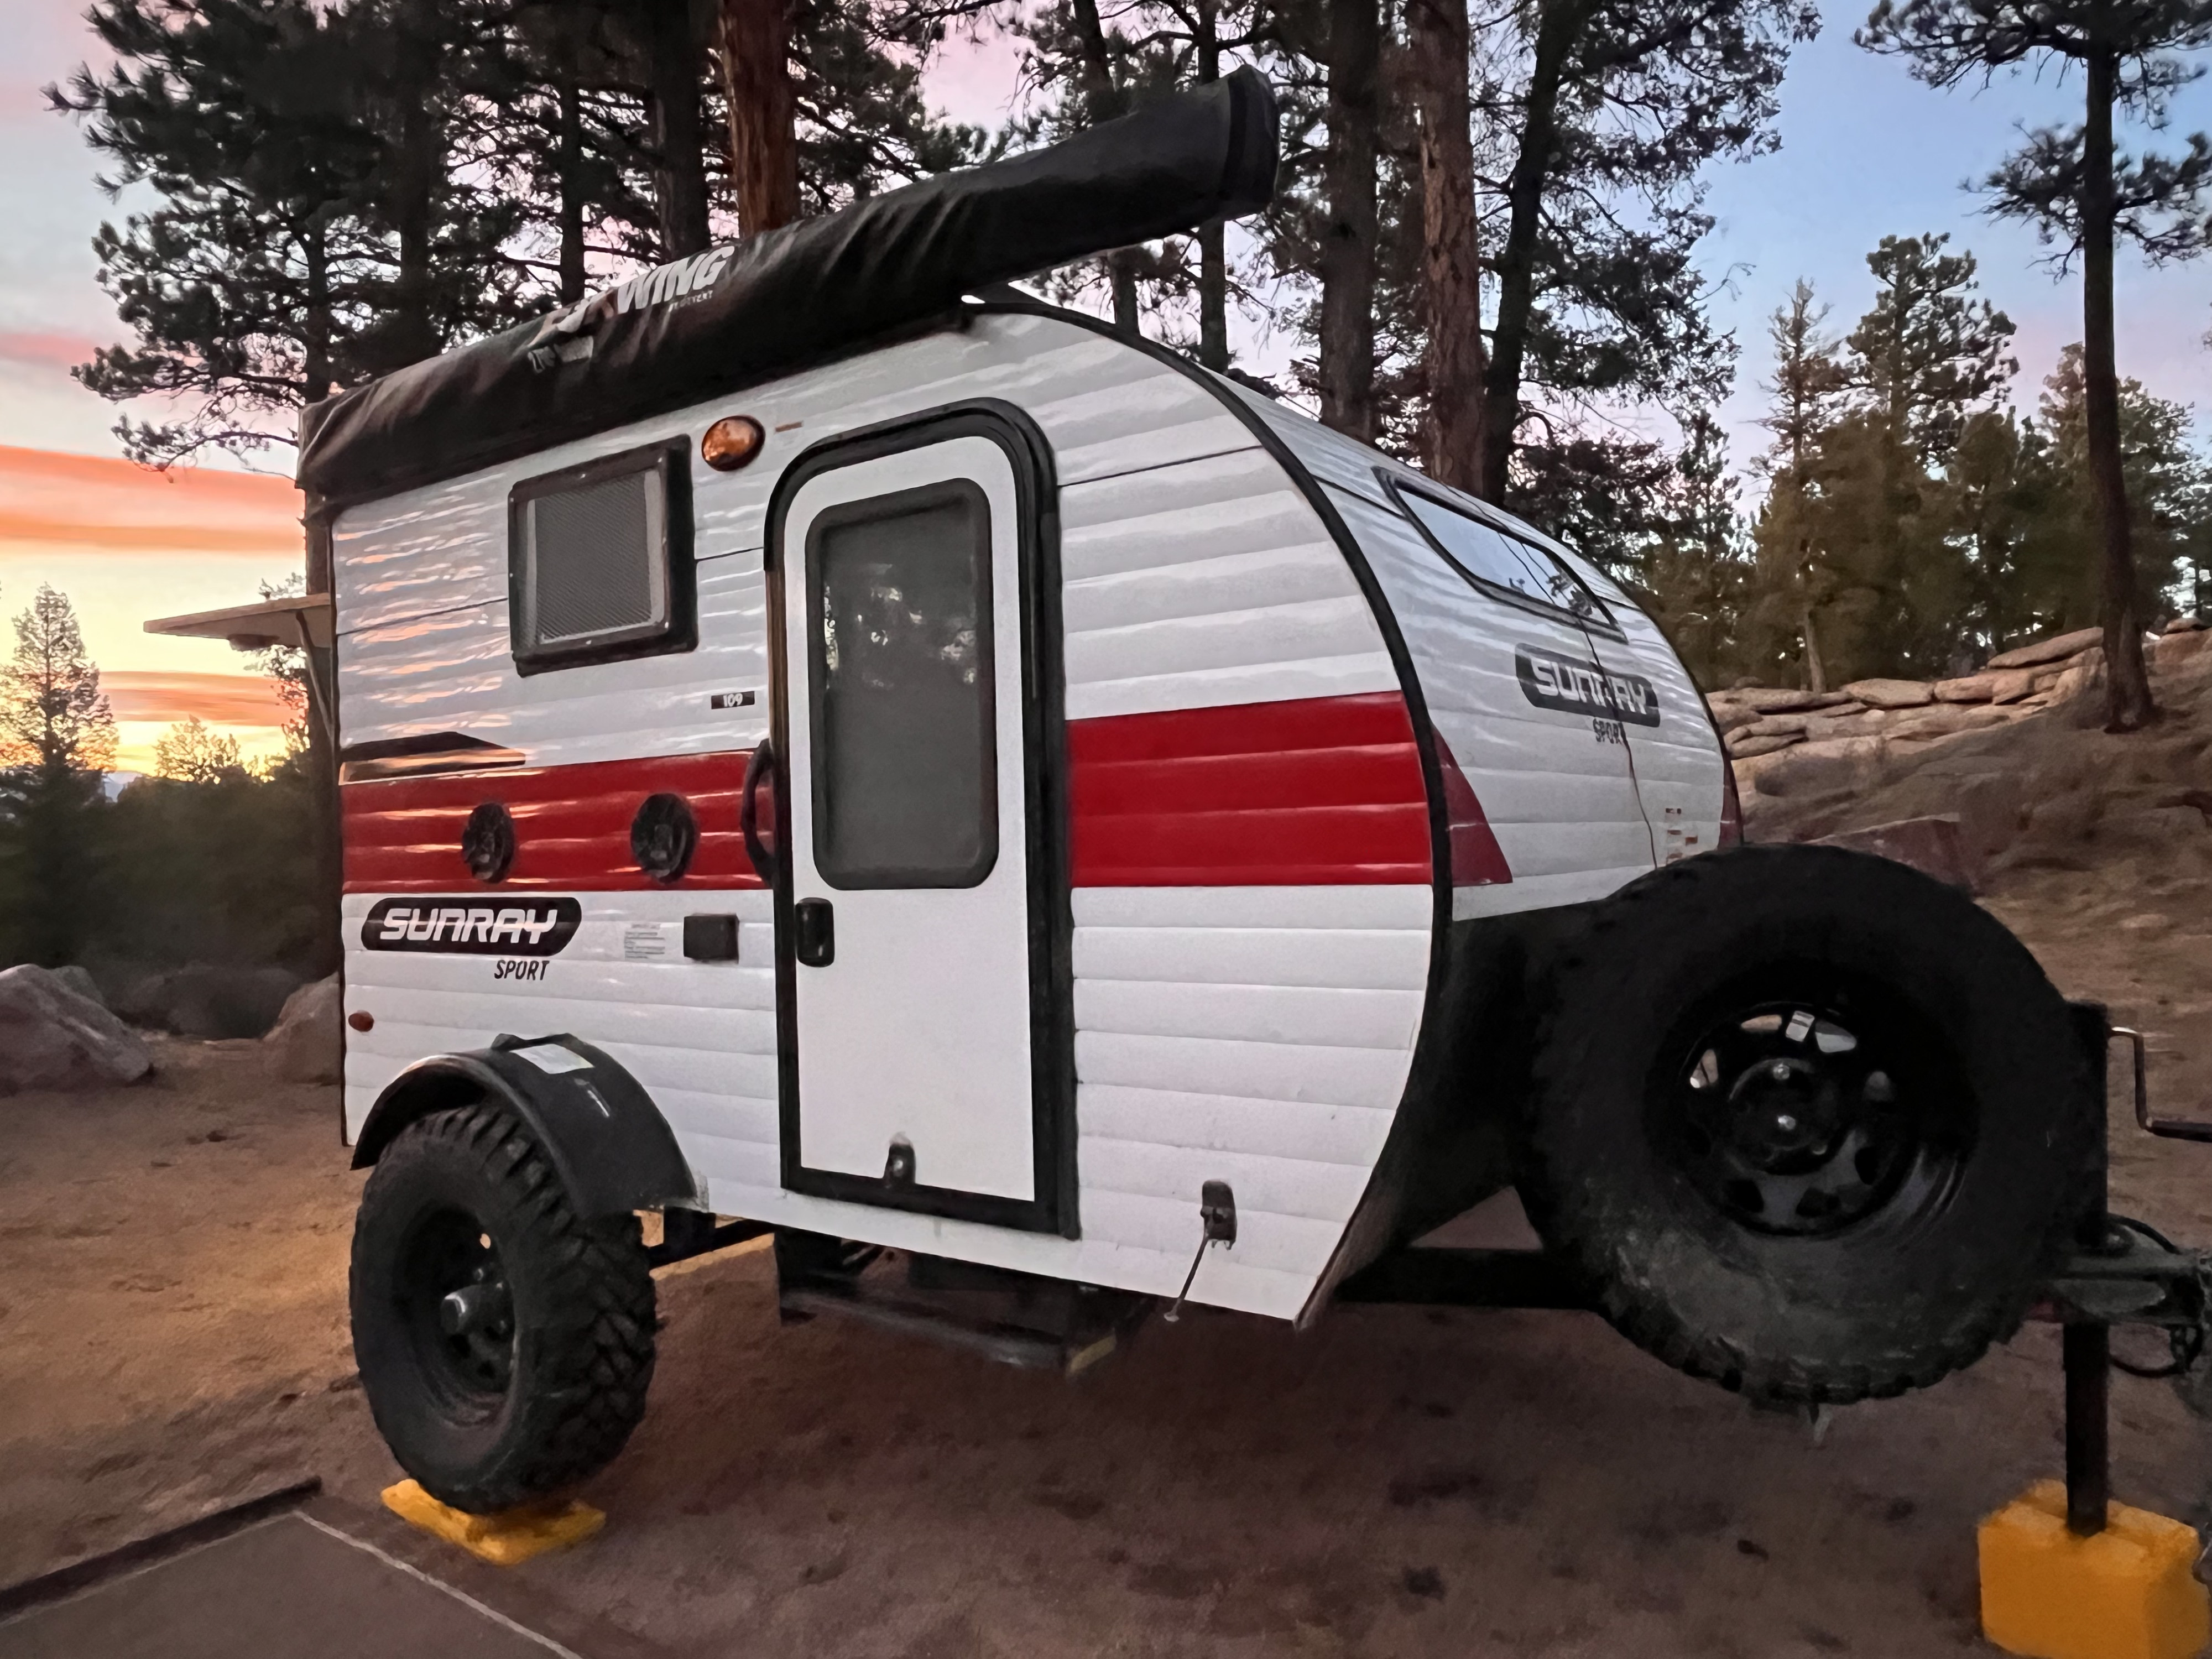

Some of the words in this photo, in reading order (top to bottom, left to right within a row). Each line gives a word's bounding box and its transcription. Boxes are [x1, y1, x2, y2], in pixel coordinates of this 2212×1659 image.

[723, 693, 743, 707] 109
[380, 908, 557, 944] SUNRAY
[494, 959, 550, 980] SPORT
